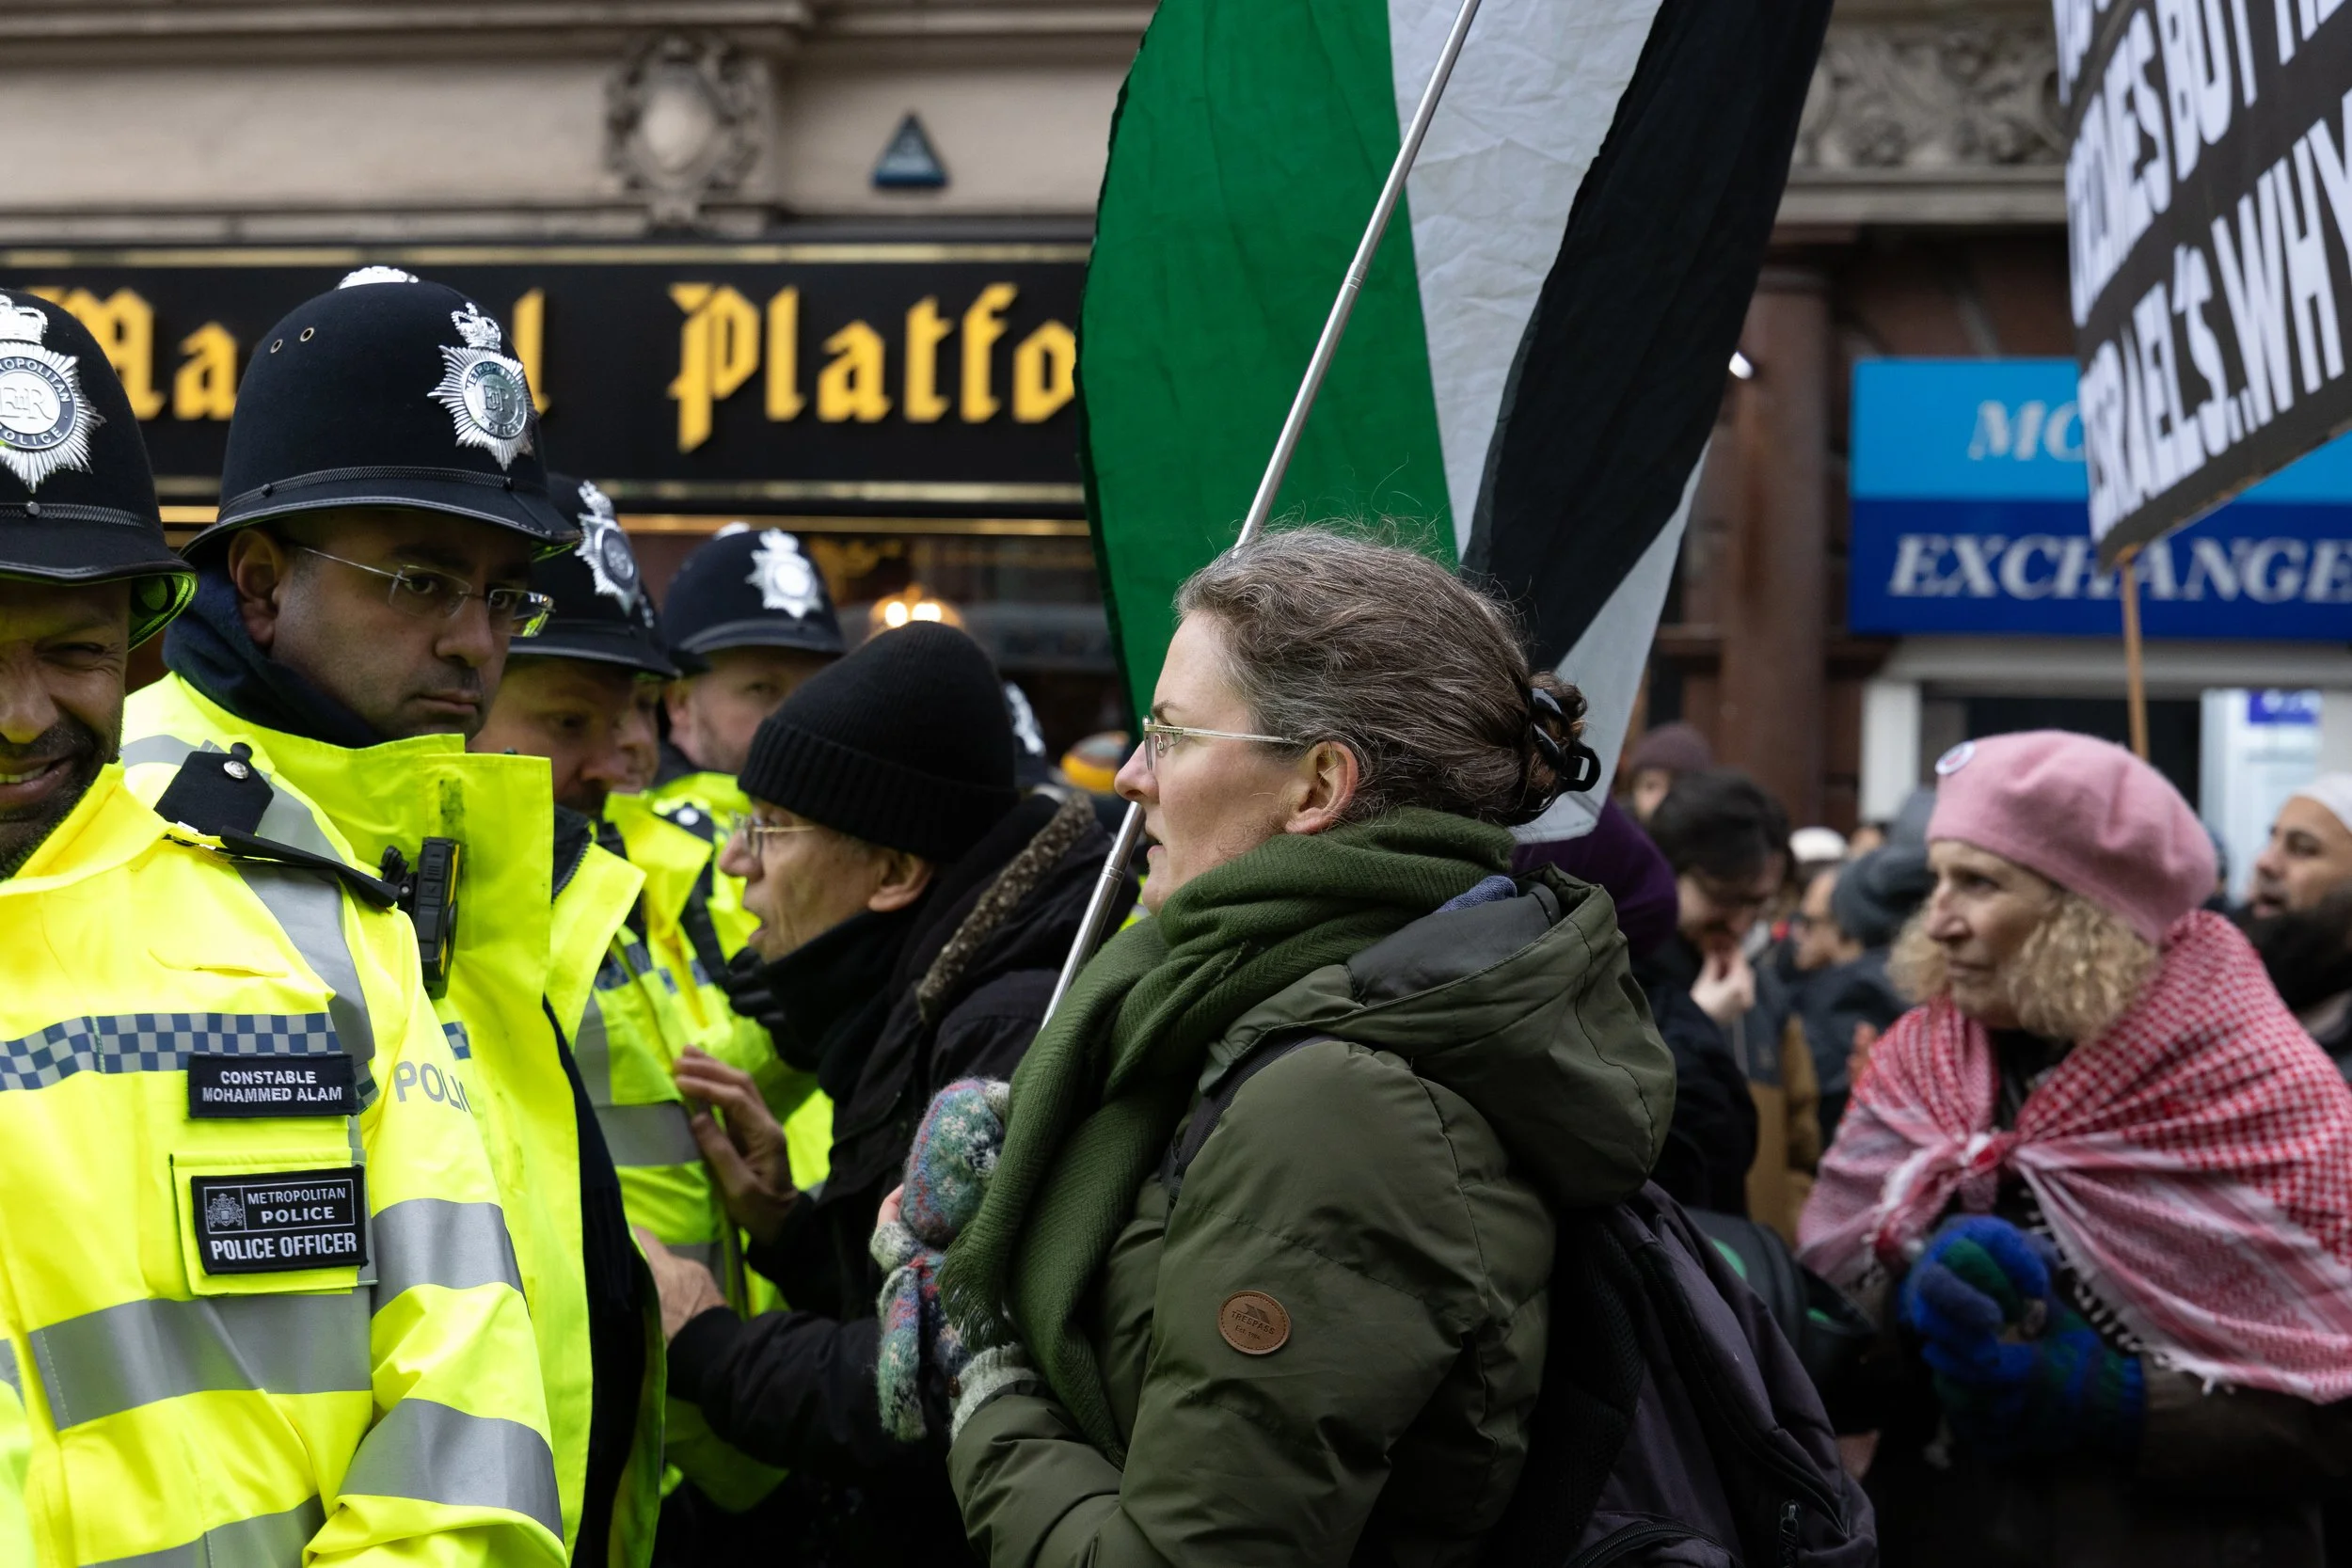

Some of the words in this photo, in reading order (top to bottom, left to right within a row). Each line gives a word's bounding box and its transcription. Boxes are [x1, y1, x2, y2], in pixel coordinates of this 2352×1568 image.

[0, 357, 72, 403] OPOLITAN
[668, 283, 1075, 454] Platfo
[0, 423, 63, 445] OLICE
[220, 1070, 317, 1085] CONSTABLE
[393, 1061, 473, 1115] POLI
[202, 1086, 292, 1102] MOHAMMED
[296, 1086, 342, 1101] ALAM
[246, 1187, 346, 1205] METROPOLITAN
[261, 1207, 335, 1223] POLICE
[210, 1238, 276, 1260] POLICE
[279, 1232, 358, 1257] OFFICER
[1232, 1310, 1276, 1335] TRESPASS
